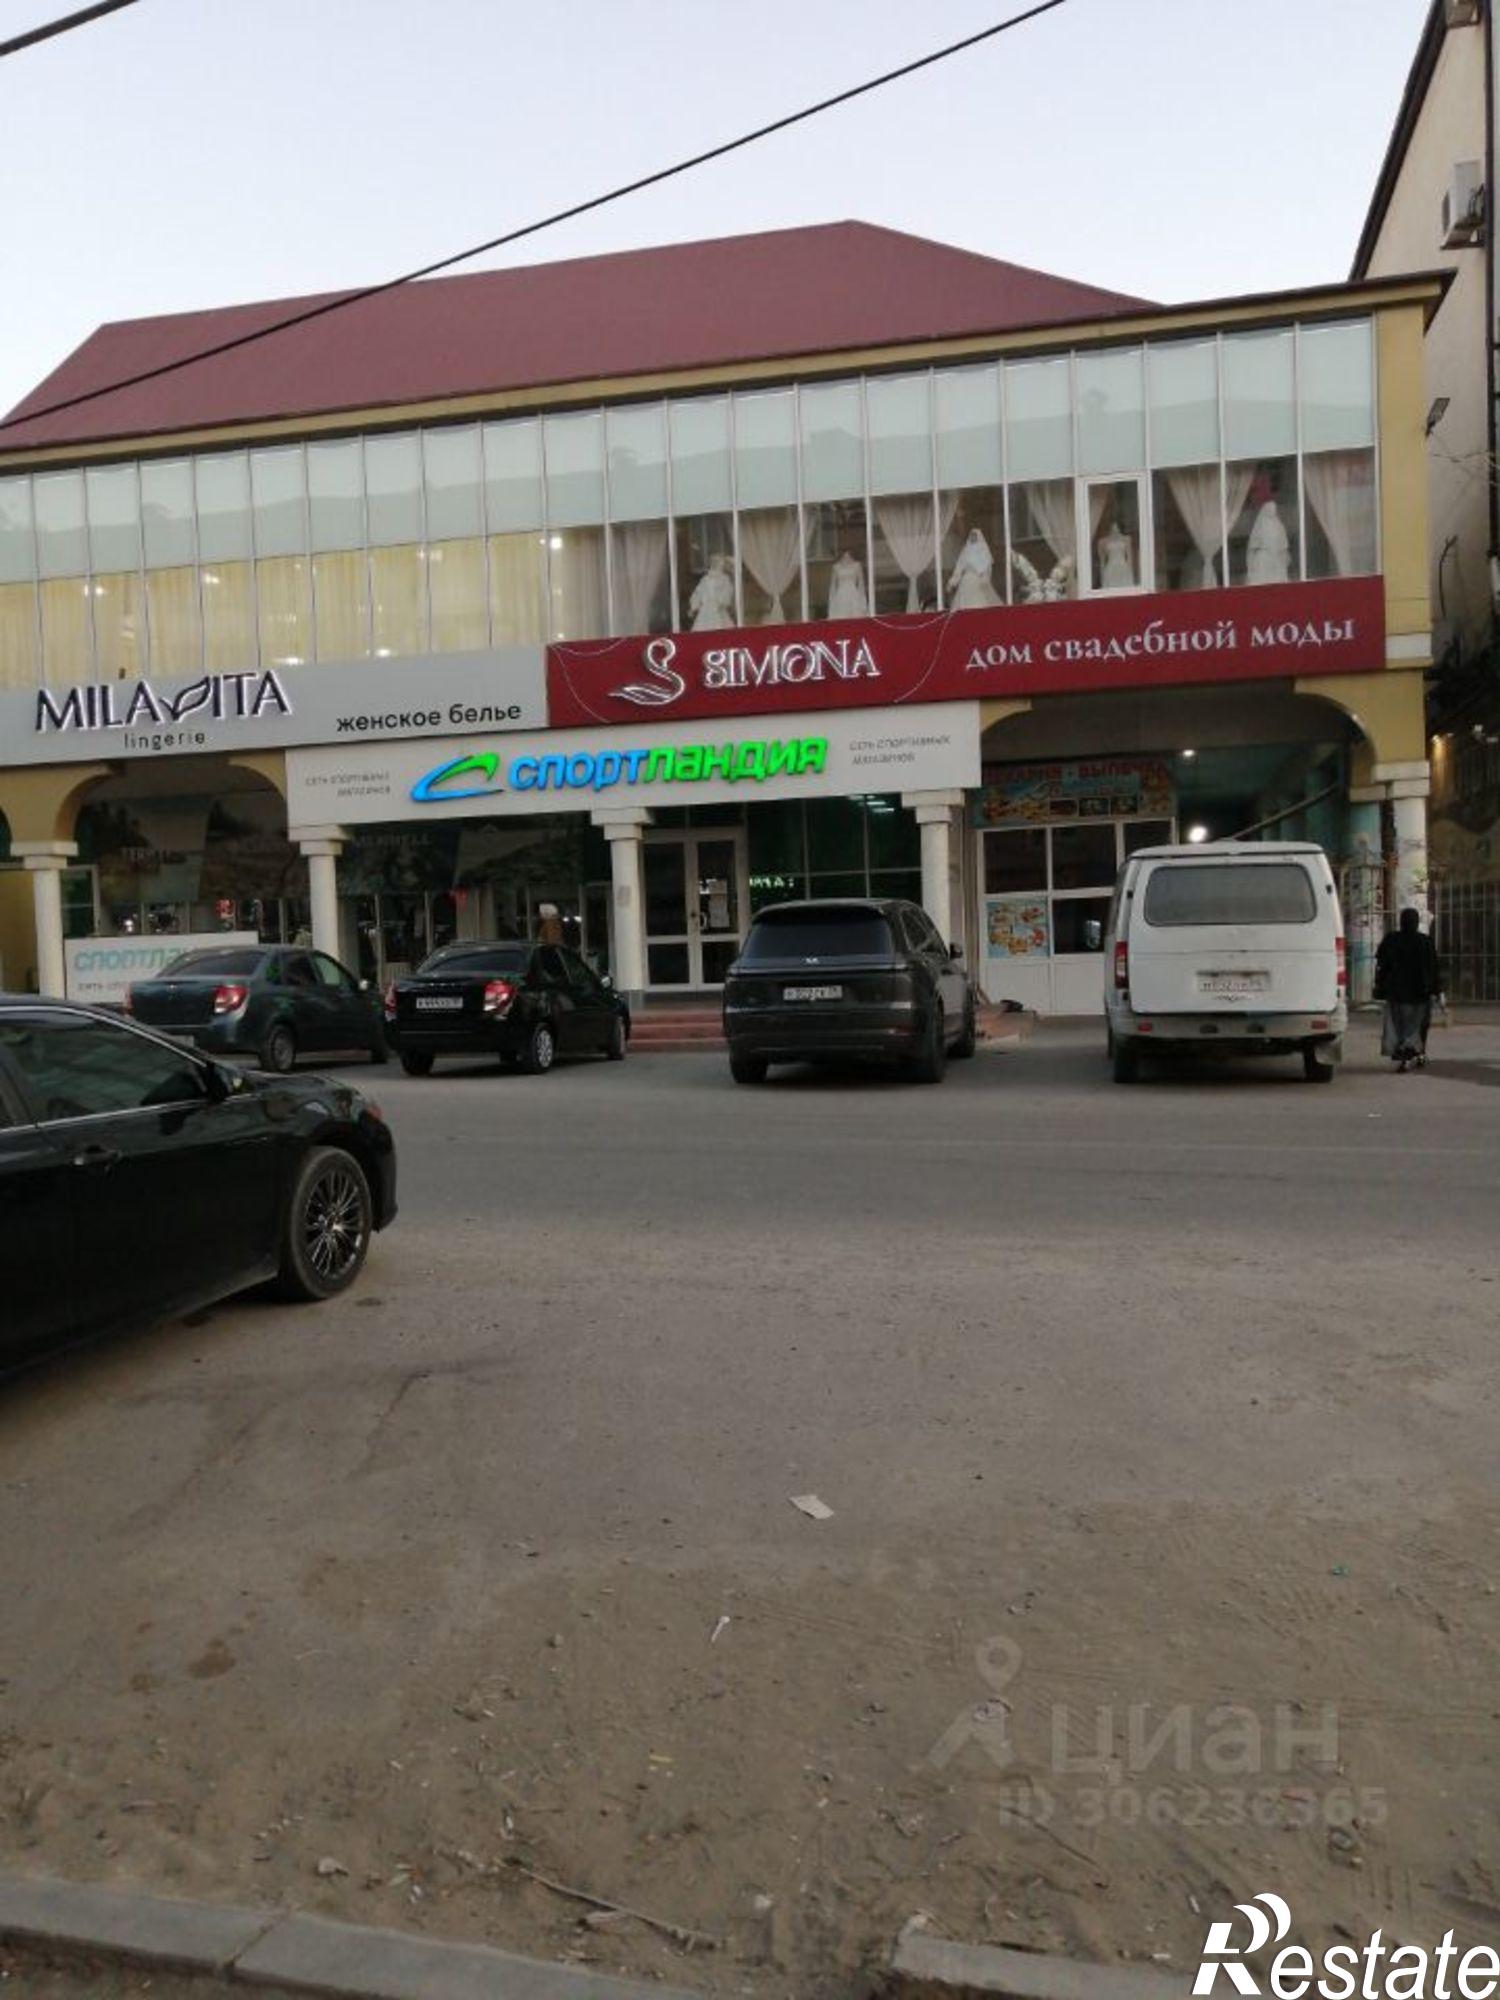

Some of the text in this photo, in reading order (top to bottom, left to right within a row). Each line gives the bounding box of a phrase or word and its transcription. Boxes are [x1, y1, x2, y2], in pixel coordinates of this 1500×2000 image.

[703, 638, 882, 689] SIMONA
[965, 618, 1355, 670] дом свадебной моды
[336, 703, 522, 732] женское белье
[124, 732, 206, 750] lingerie
